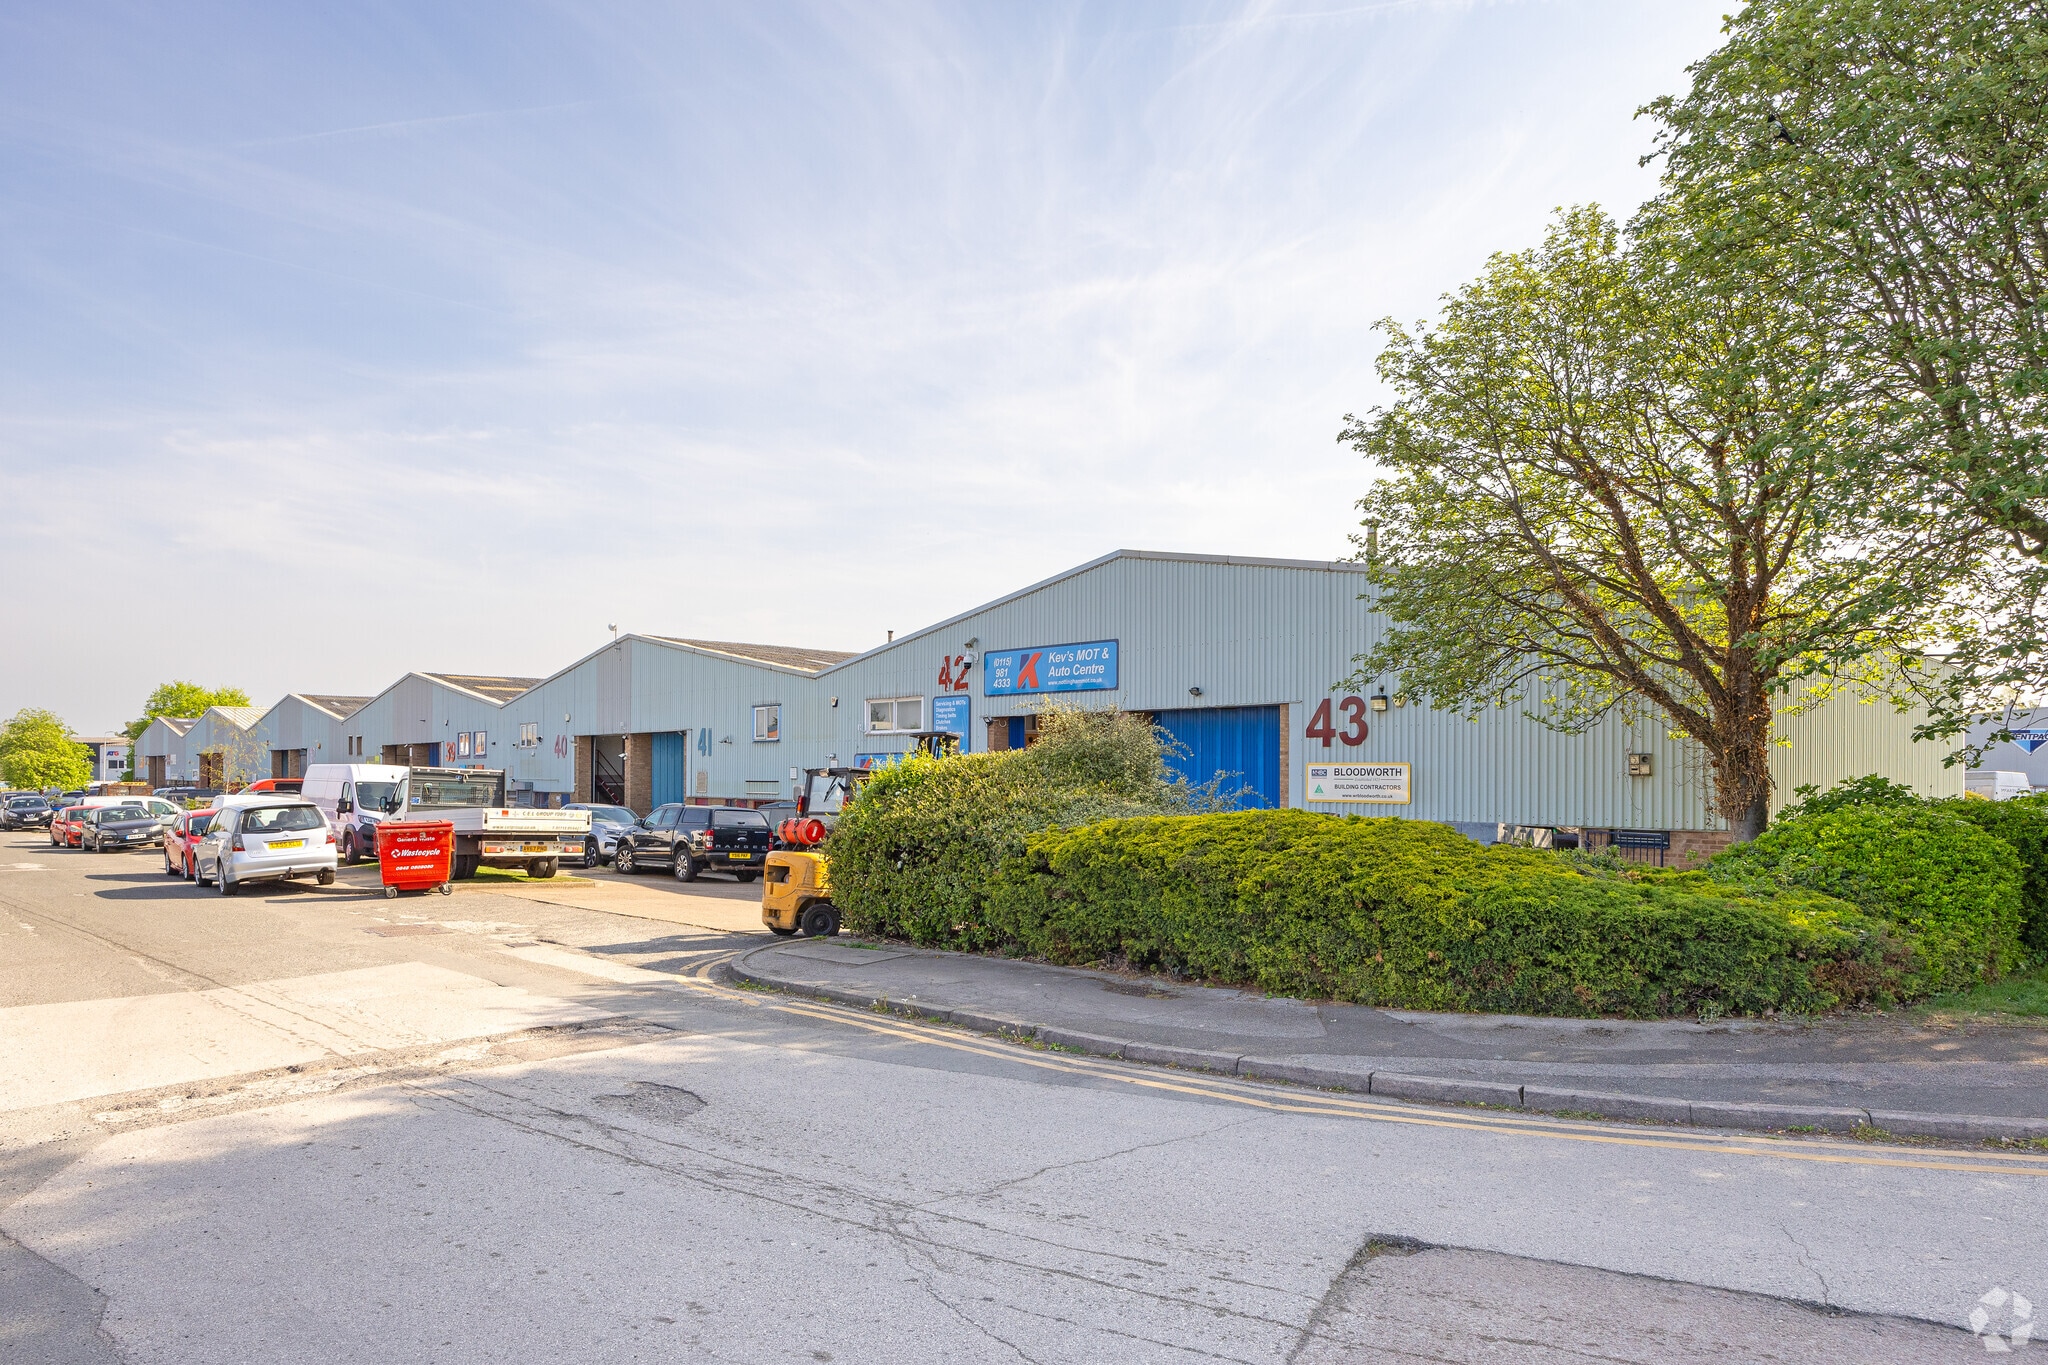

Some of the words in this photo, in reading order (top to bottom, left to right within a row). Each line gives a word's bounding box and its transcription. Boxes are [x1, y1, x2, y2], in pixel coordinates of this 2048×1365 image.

[993, 656, 1012, 667] (0115)
[1048, 651, 1074, 663] Kev's
[1076, 648, 1100, 661] MOT
[1101, 647, 1110, 659] &
[938, 655, 969, 692] 42
[995, 668, 1009, 678] 981
[1048, 665, 1071, 677] Auto
[1072, 663, 1105, 675] Centre
[993, 678, 1011, 688] 4333
[1306, 696, 1369, 747] 43
[554, 734, 568, 759] 40
[698, 728, 712, 757] 41
[445, 741, 456, 763] 39
[1333, 768, 1402, 776] BLOODWORTH
[401, 847, 441, 858] Wastecycle
